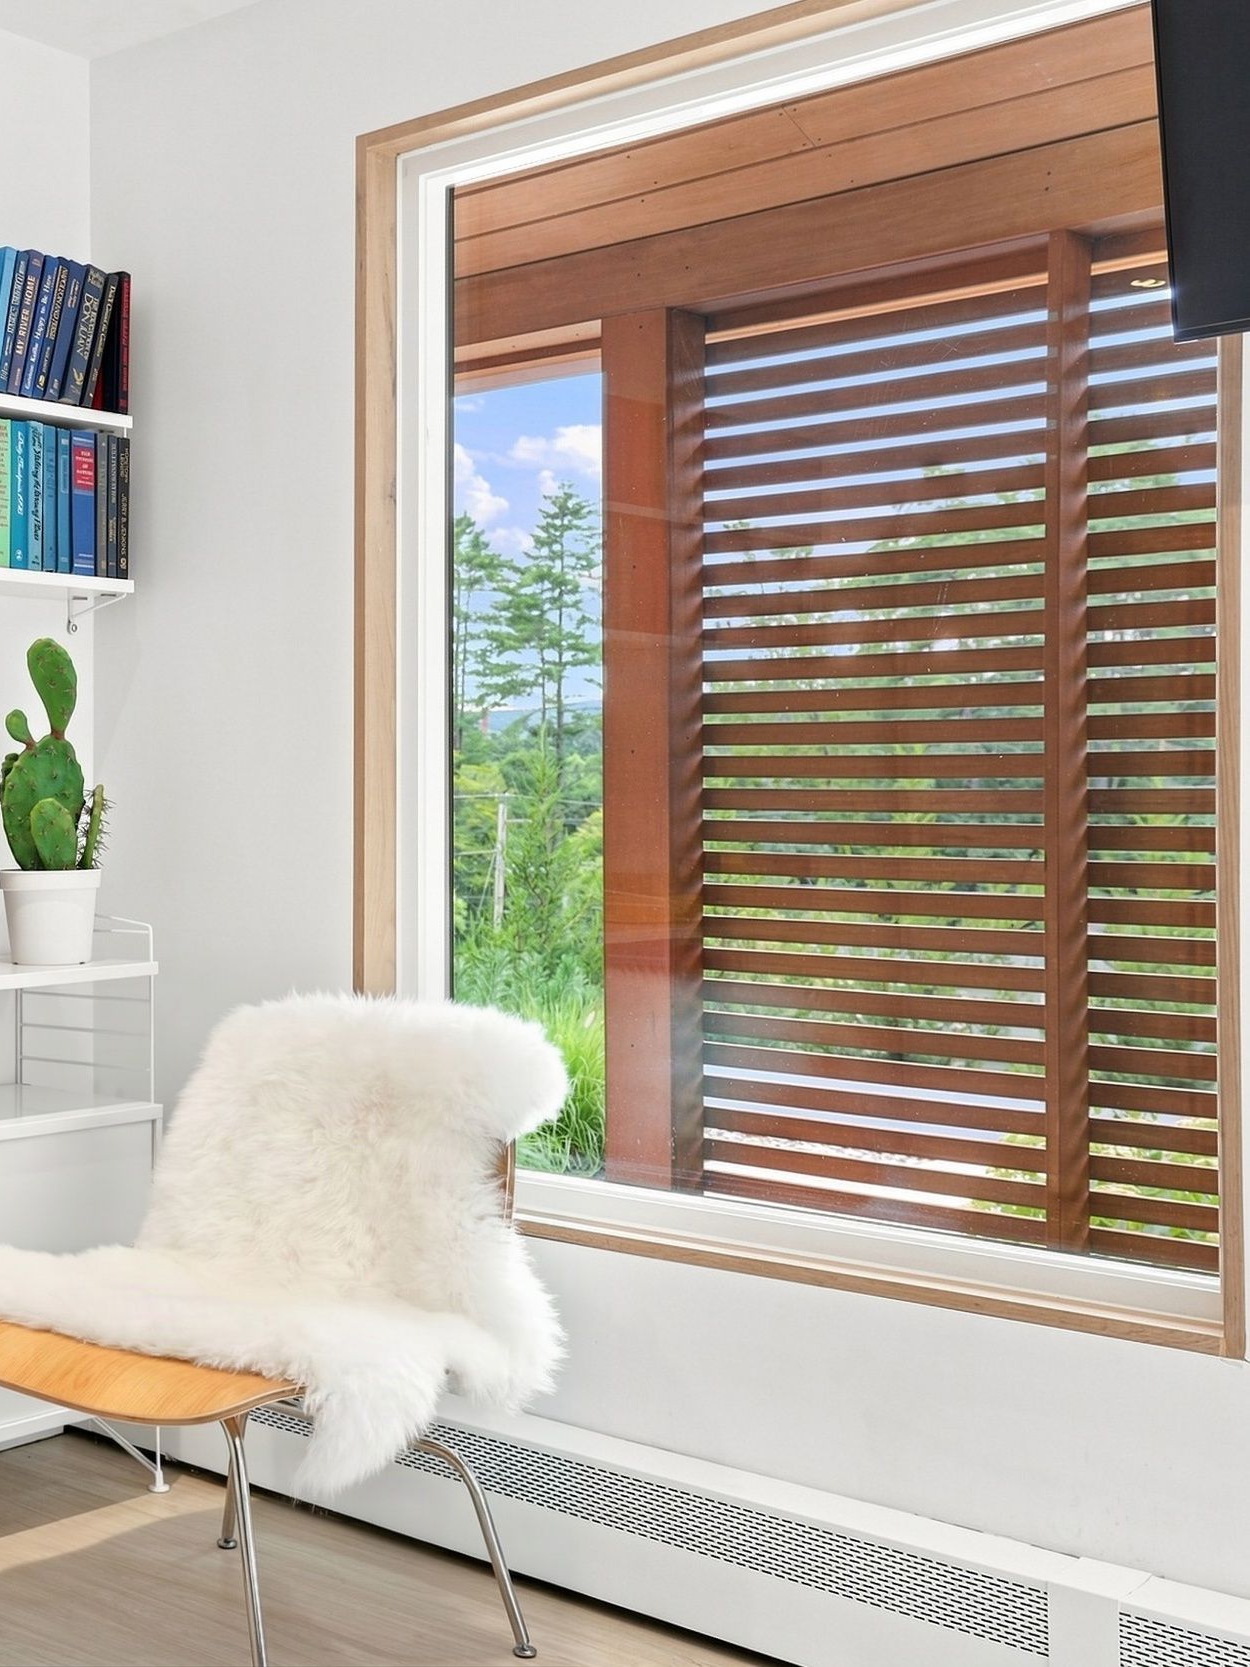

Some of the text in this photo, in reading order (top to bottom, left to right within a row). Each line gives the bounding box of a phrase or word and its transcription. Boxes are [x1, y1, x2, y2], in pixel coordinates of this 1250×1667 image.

[16, 275, 36, 354] MY RIVER HOME
[81, 292, 92, 322] DON
